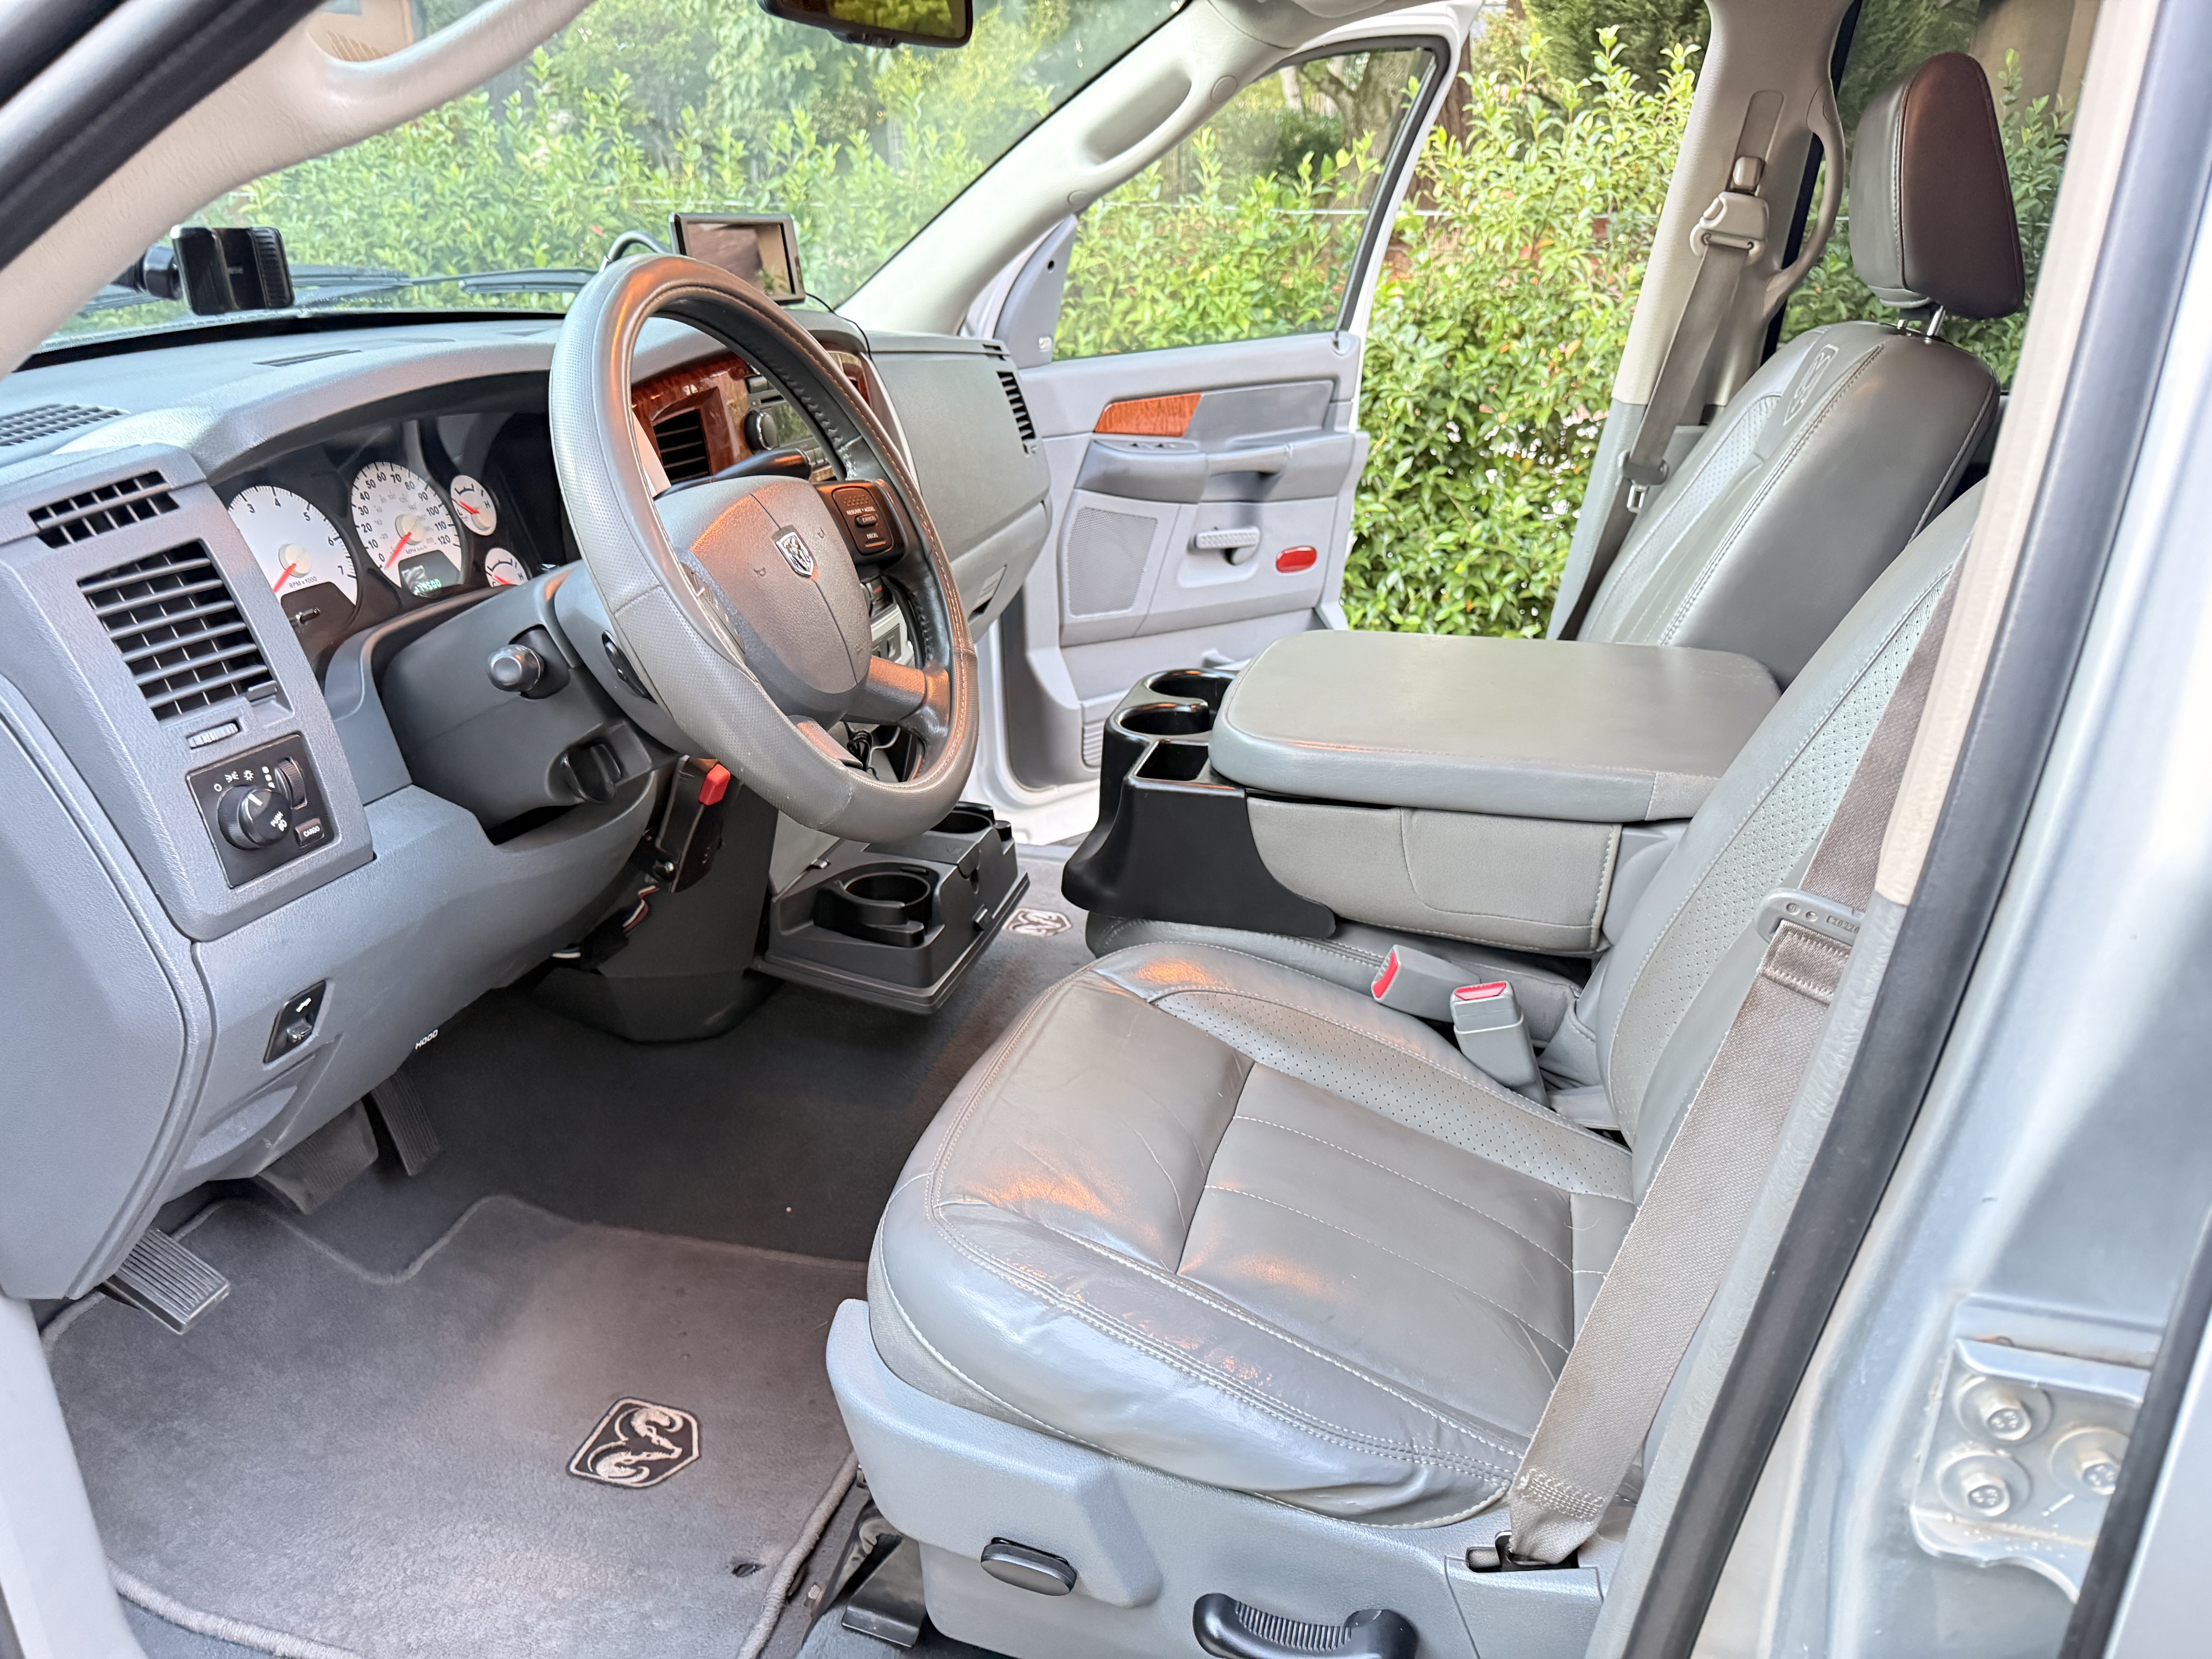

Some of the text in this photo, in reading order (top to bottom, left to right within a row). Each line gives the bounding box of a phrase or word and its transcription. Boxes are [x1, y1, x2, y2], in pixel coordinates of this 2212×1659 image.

[377, 472, 386, 482] 60
[390, 474, 401, 483] 70
[366, 479, 376, 489] 50
[405, 481, 415, 490] 80
[360, 491, 370, 501] 40
[418, 492, 428, 501] 90
[275, 498, 282, 507] 4
[247, 503, 255, 514] 3
[358, 505, 369, 515] 30
[426, 506, 440, 516] 100
[303, 512, 311, 521] 5
[361, 523, 373, 533] 20
[434, 521, 447, 531] 110
[328, 536, 334, 546] 6
[368, 539, 378, 549] 10
[438, 535, 451, 545] 120
[379, 553, 385, 562] 0
[338, 565, 343, 575] 7
[289, 580, 302, 589] RPM
[304, 826, 320, 837] CARGO
[415, 1029, 438, 1049] HOOD
